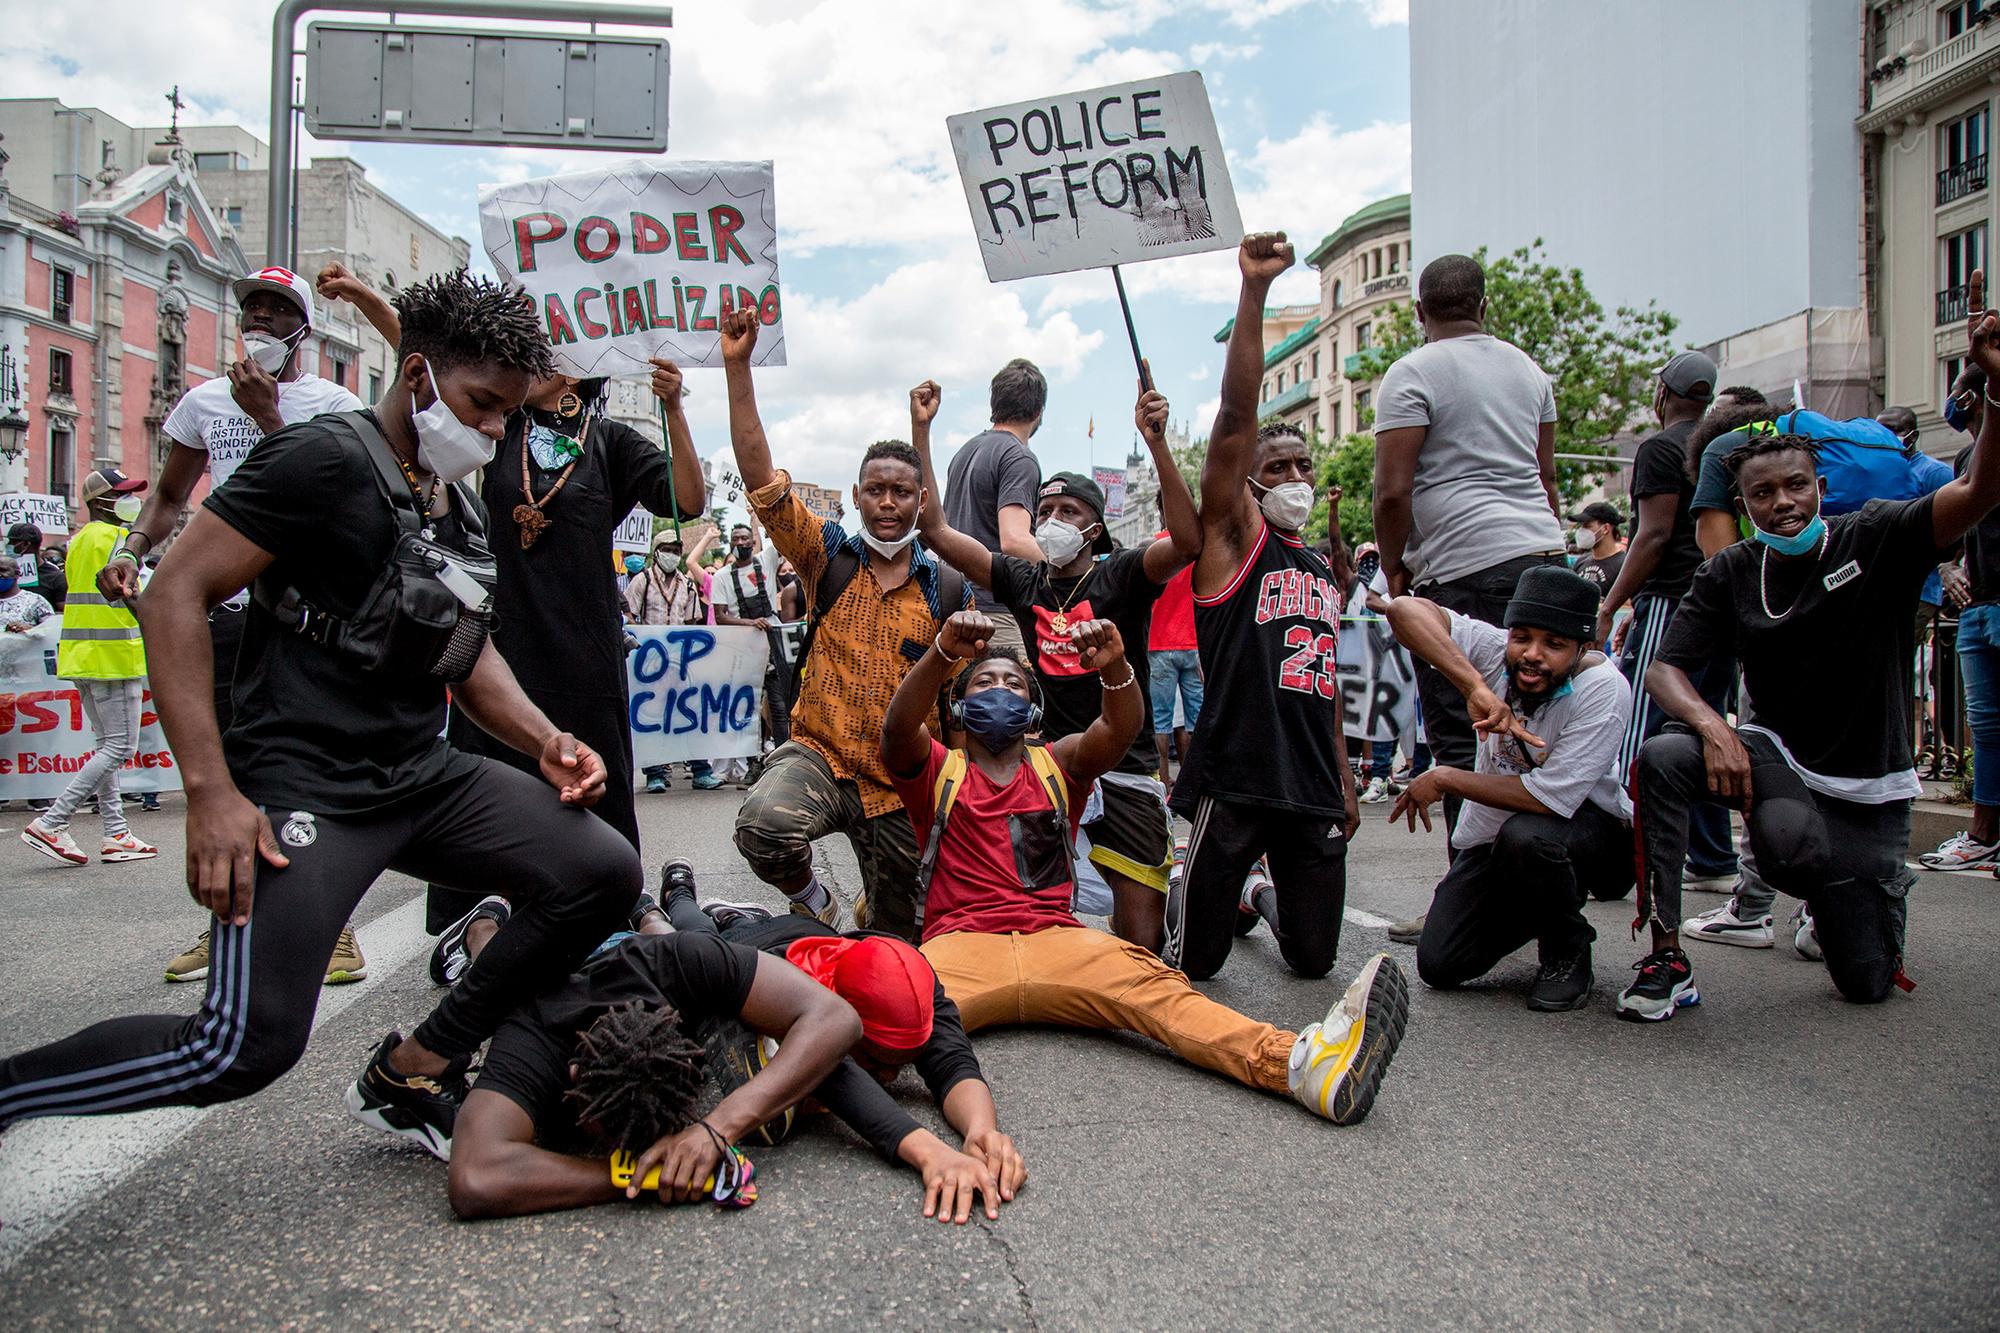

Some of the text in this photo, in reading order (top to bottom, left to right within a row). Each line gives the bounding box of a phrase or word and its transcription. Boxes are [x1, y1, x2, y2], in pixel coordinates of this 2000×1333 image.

[983, 90, 1167, 166] POLICE
[979, 145, 1210, 237] REFORM
[512, 203, 755, 274] PODER
[212, 420, 223, 429] EL
[0, 499, 66, 515] ACK TRANS
[25, 512, 67, 527] MATTER
[627, 629, 717, 685] OP
[1278, 624, 1336, 701] 23
